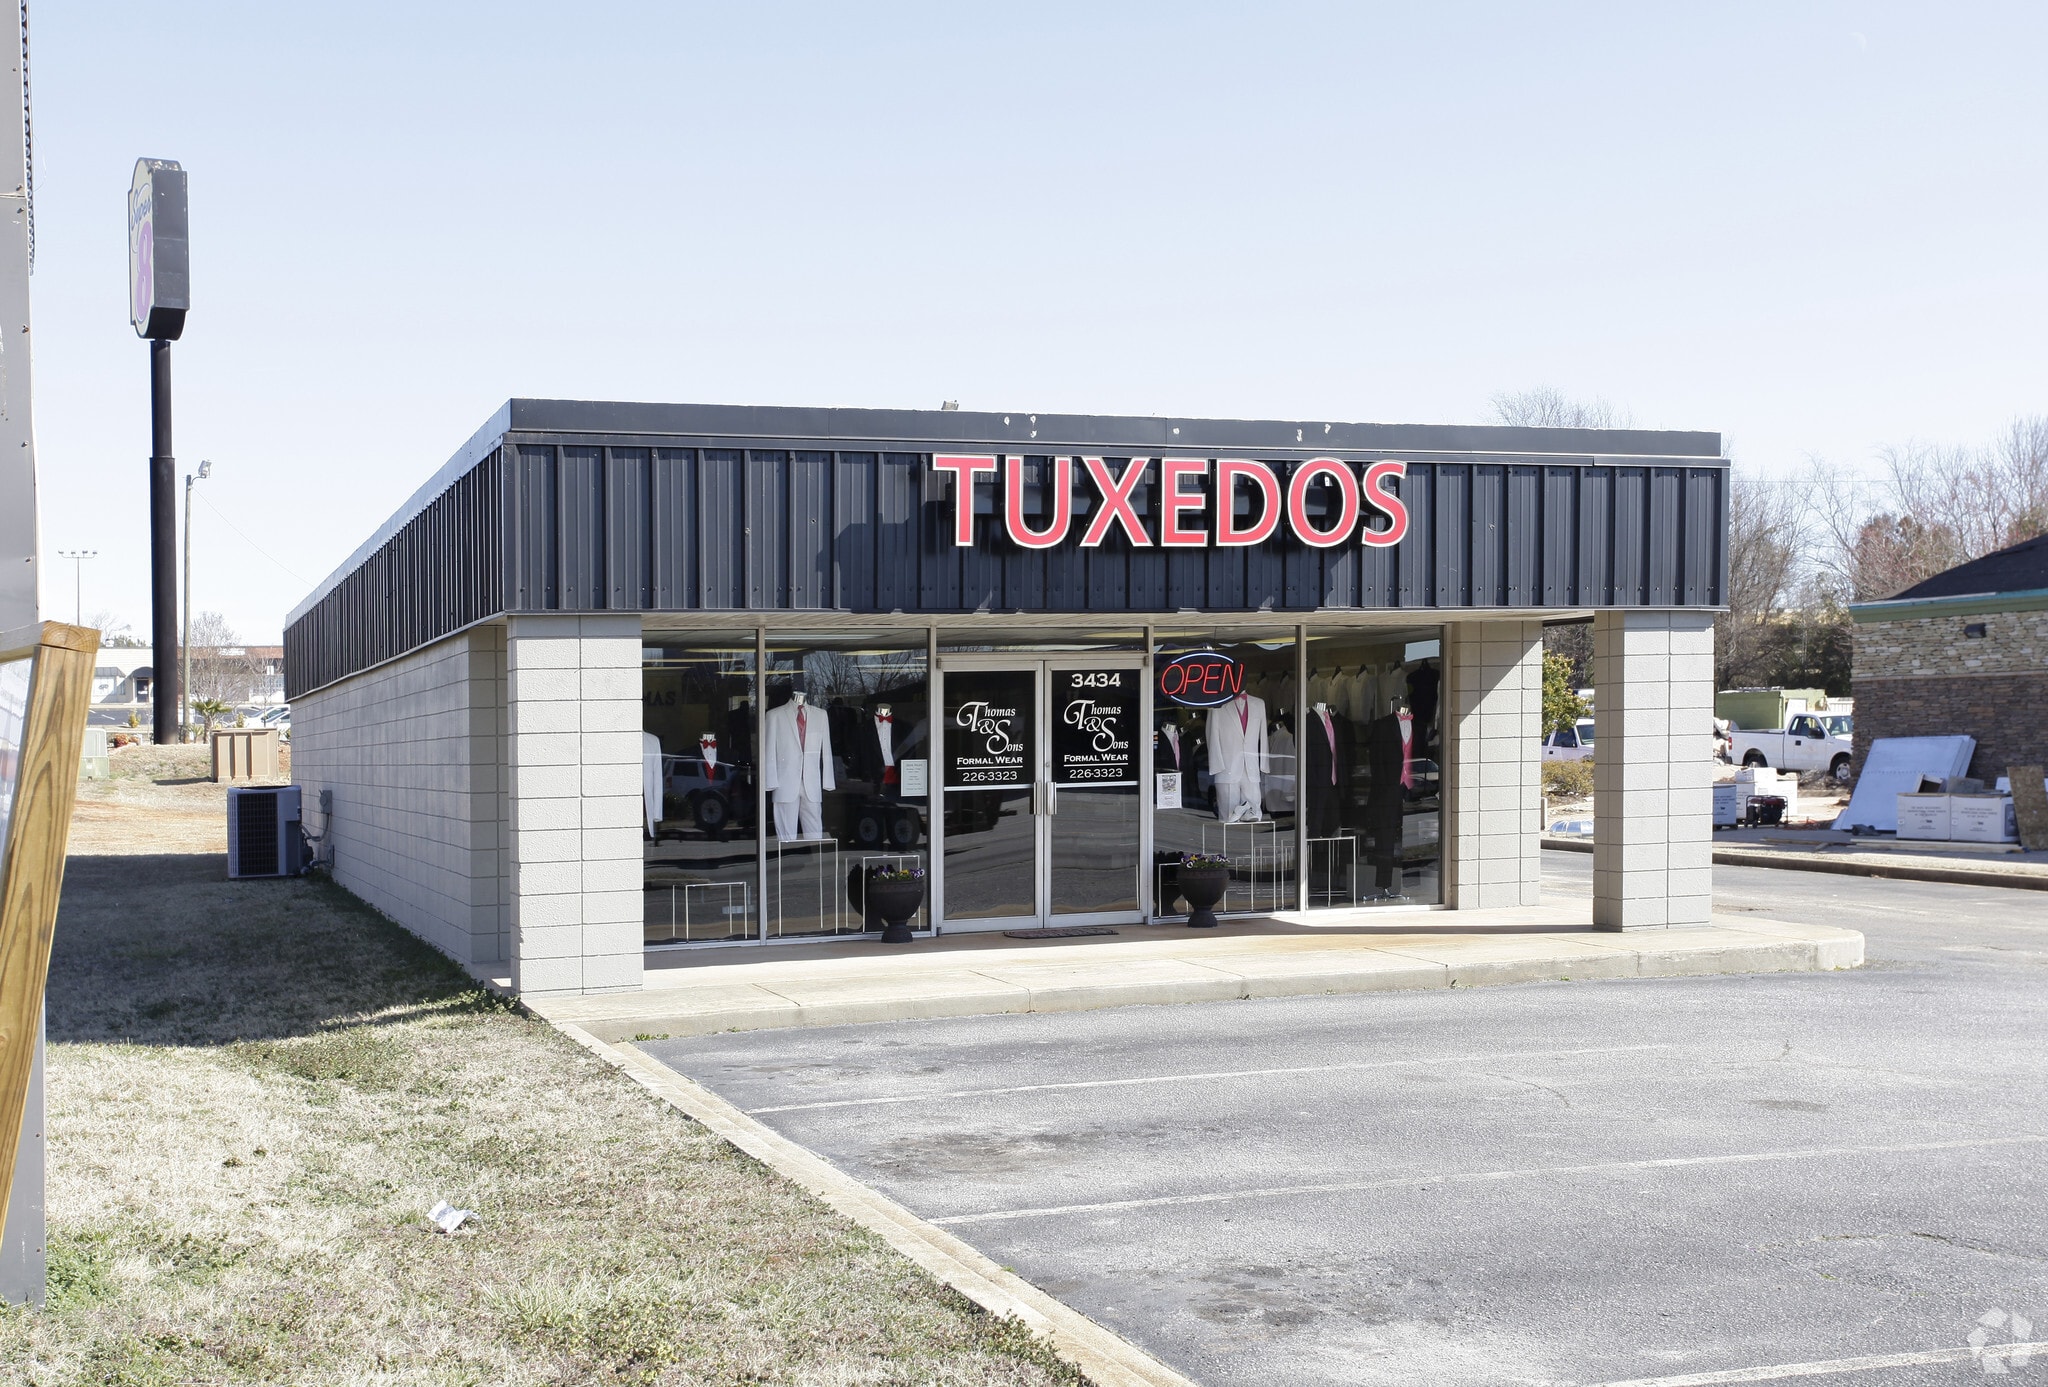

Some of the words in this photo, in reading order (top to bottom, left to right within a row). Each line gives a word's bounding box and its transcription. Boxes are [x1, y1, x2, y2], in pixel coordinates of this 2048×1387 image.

[932, 453, 1410, 549] TUXEDOS
[1071, 673, 1121, 688] 3434
[1161, 663, 1245, 695] OPEN
[956, 701, 1016, 732] Thomas
[1063, 700, 1122, 730] Thomas
[977, 718, 996, 735] &
[1084, 716, 1101, 732] &
[986, 719, 1024, 755] Sons
[1092, 717, 1129, 752] Sons
[956, 756, 994, 766] FORMAL
[995, 755, 1023, 764] WEAR
[1063, 753, 1100, 763] FORMAL
[1102, 752, 1129, 762] WEAR
[962, 770, 1018, 782] 226-3323
[1069, 768, 1123, 779] 226-3323
